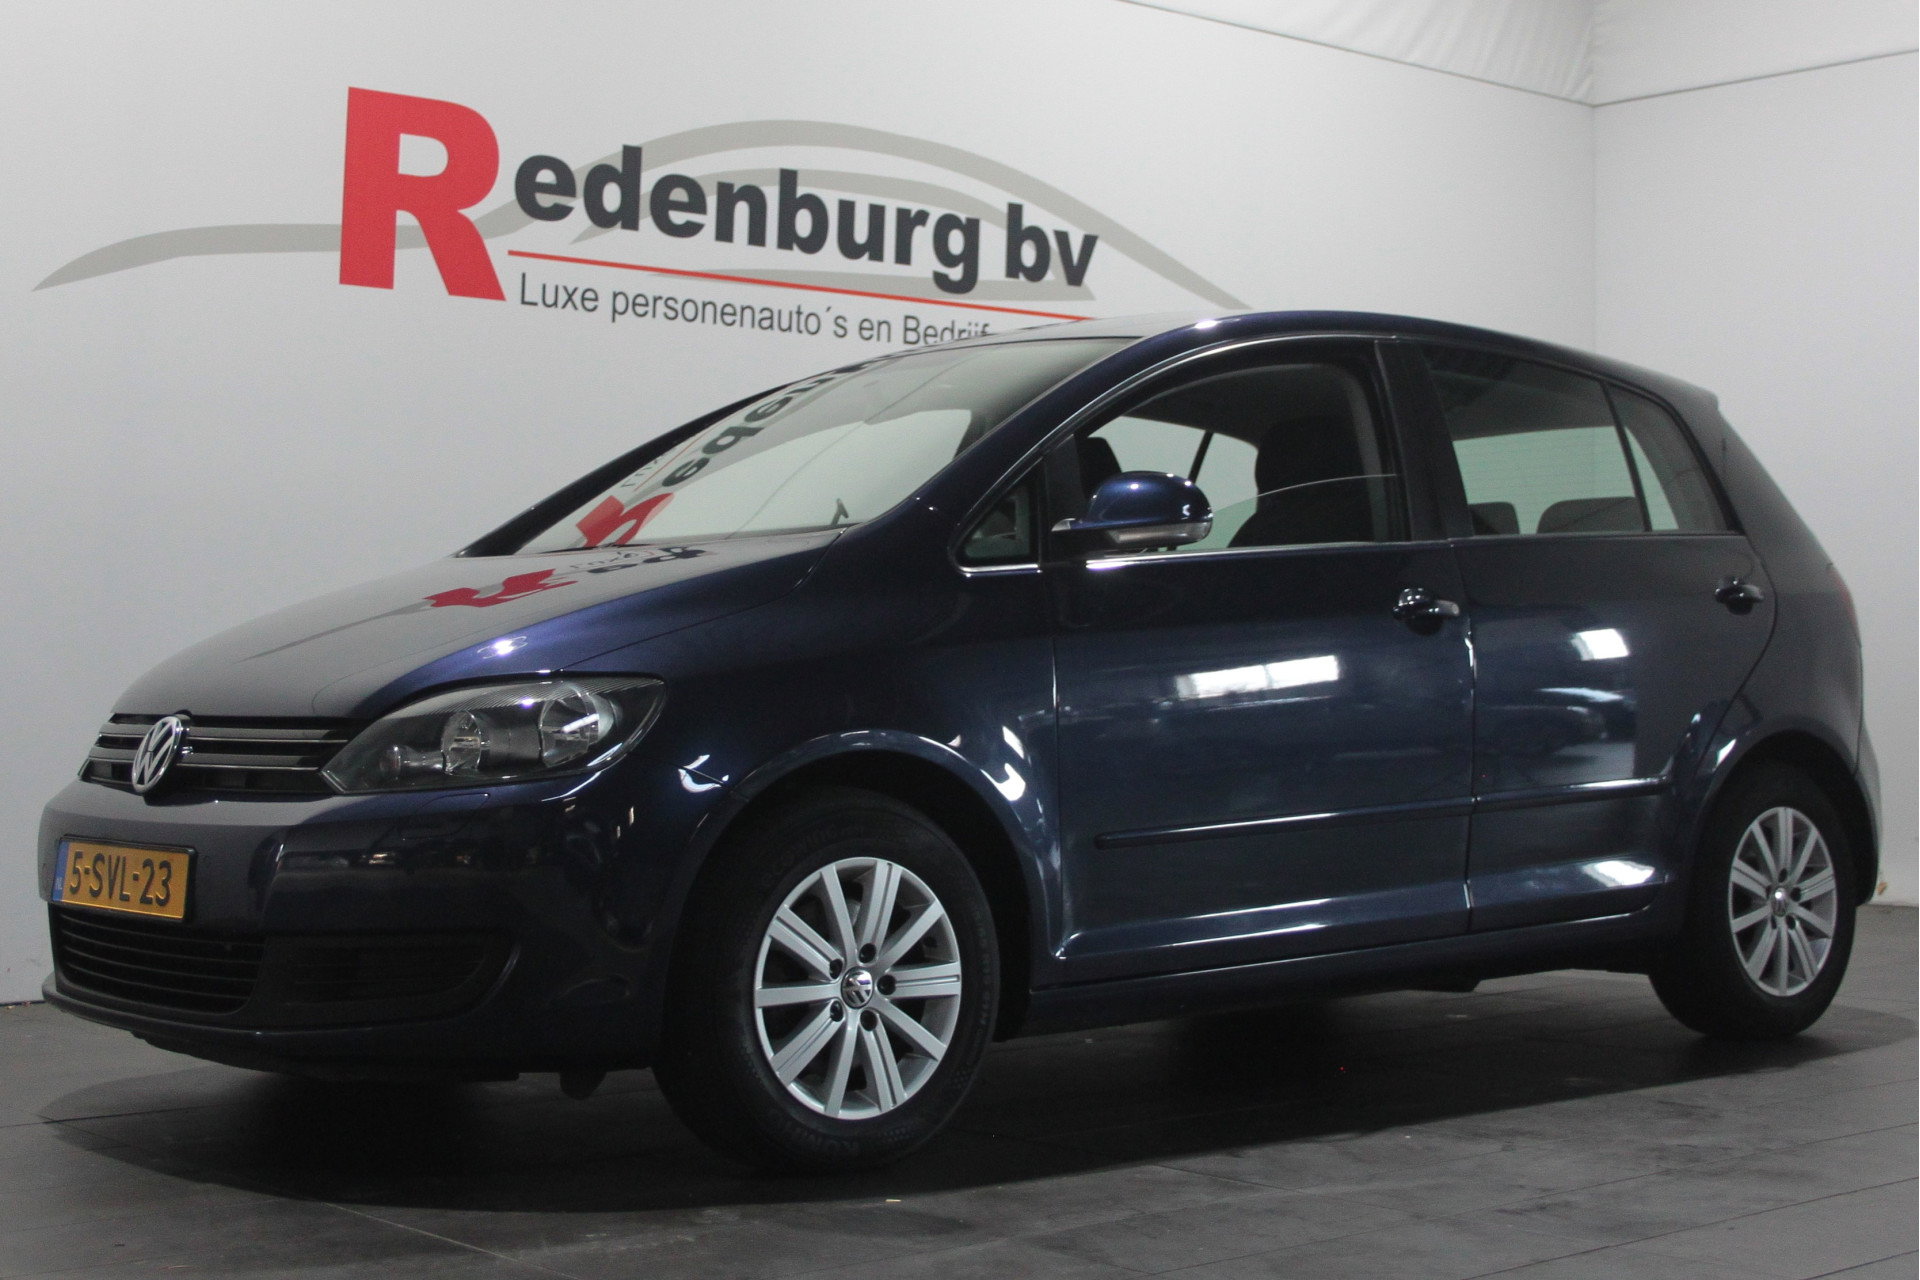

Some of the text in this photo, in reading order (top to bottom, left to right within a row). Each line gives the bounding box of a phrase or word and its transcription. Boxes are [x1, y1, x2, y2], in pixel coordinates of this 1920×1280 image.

[339, 86, 1099, 301] Redenburg bv
[520, 272, 600, 312] Luxe
[858, 317, 892, 343] en
[69, 850, 173, 907] 5-SVL-23
